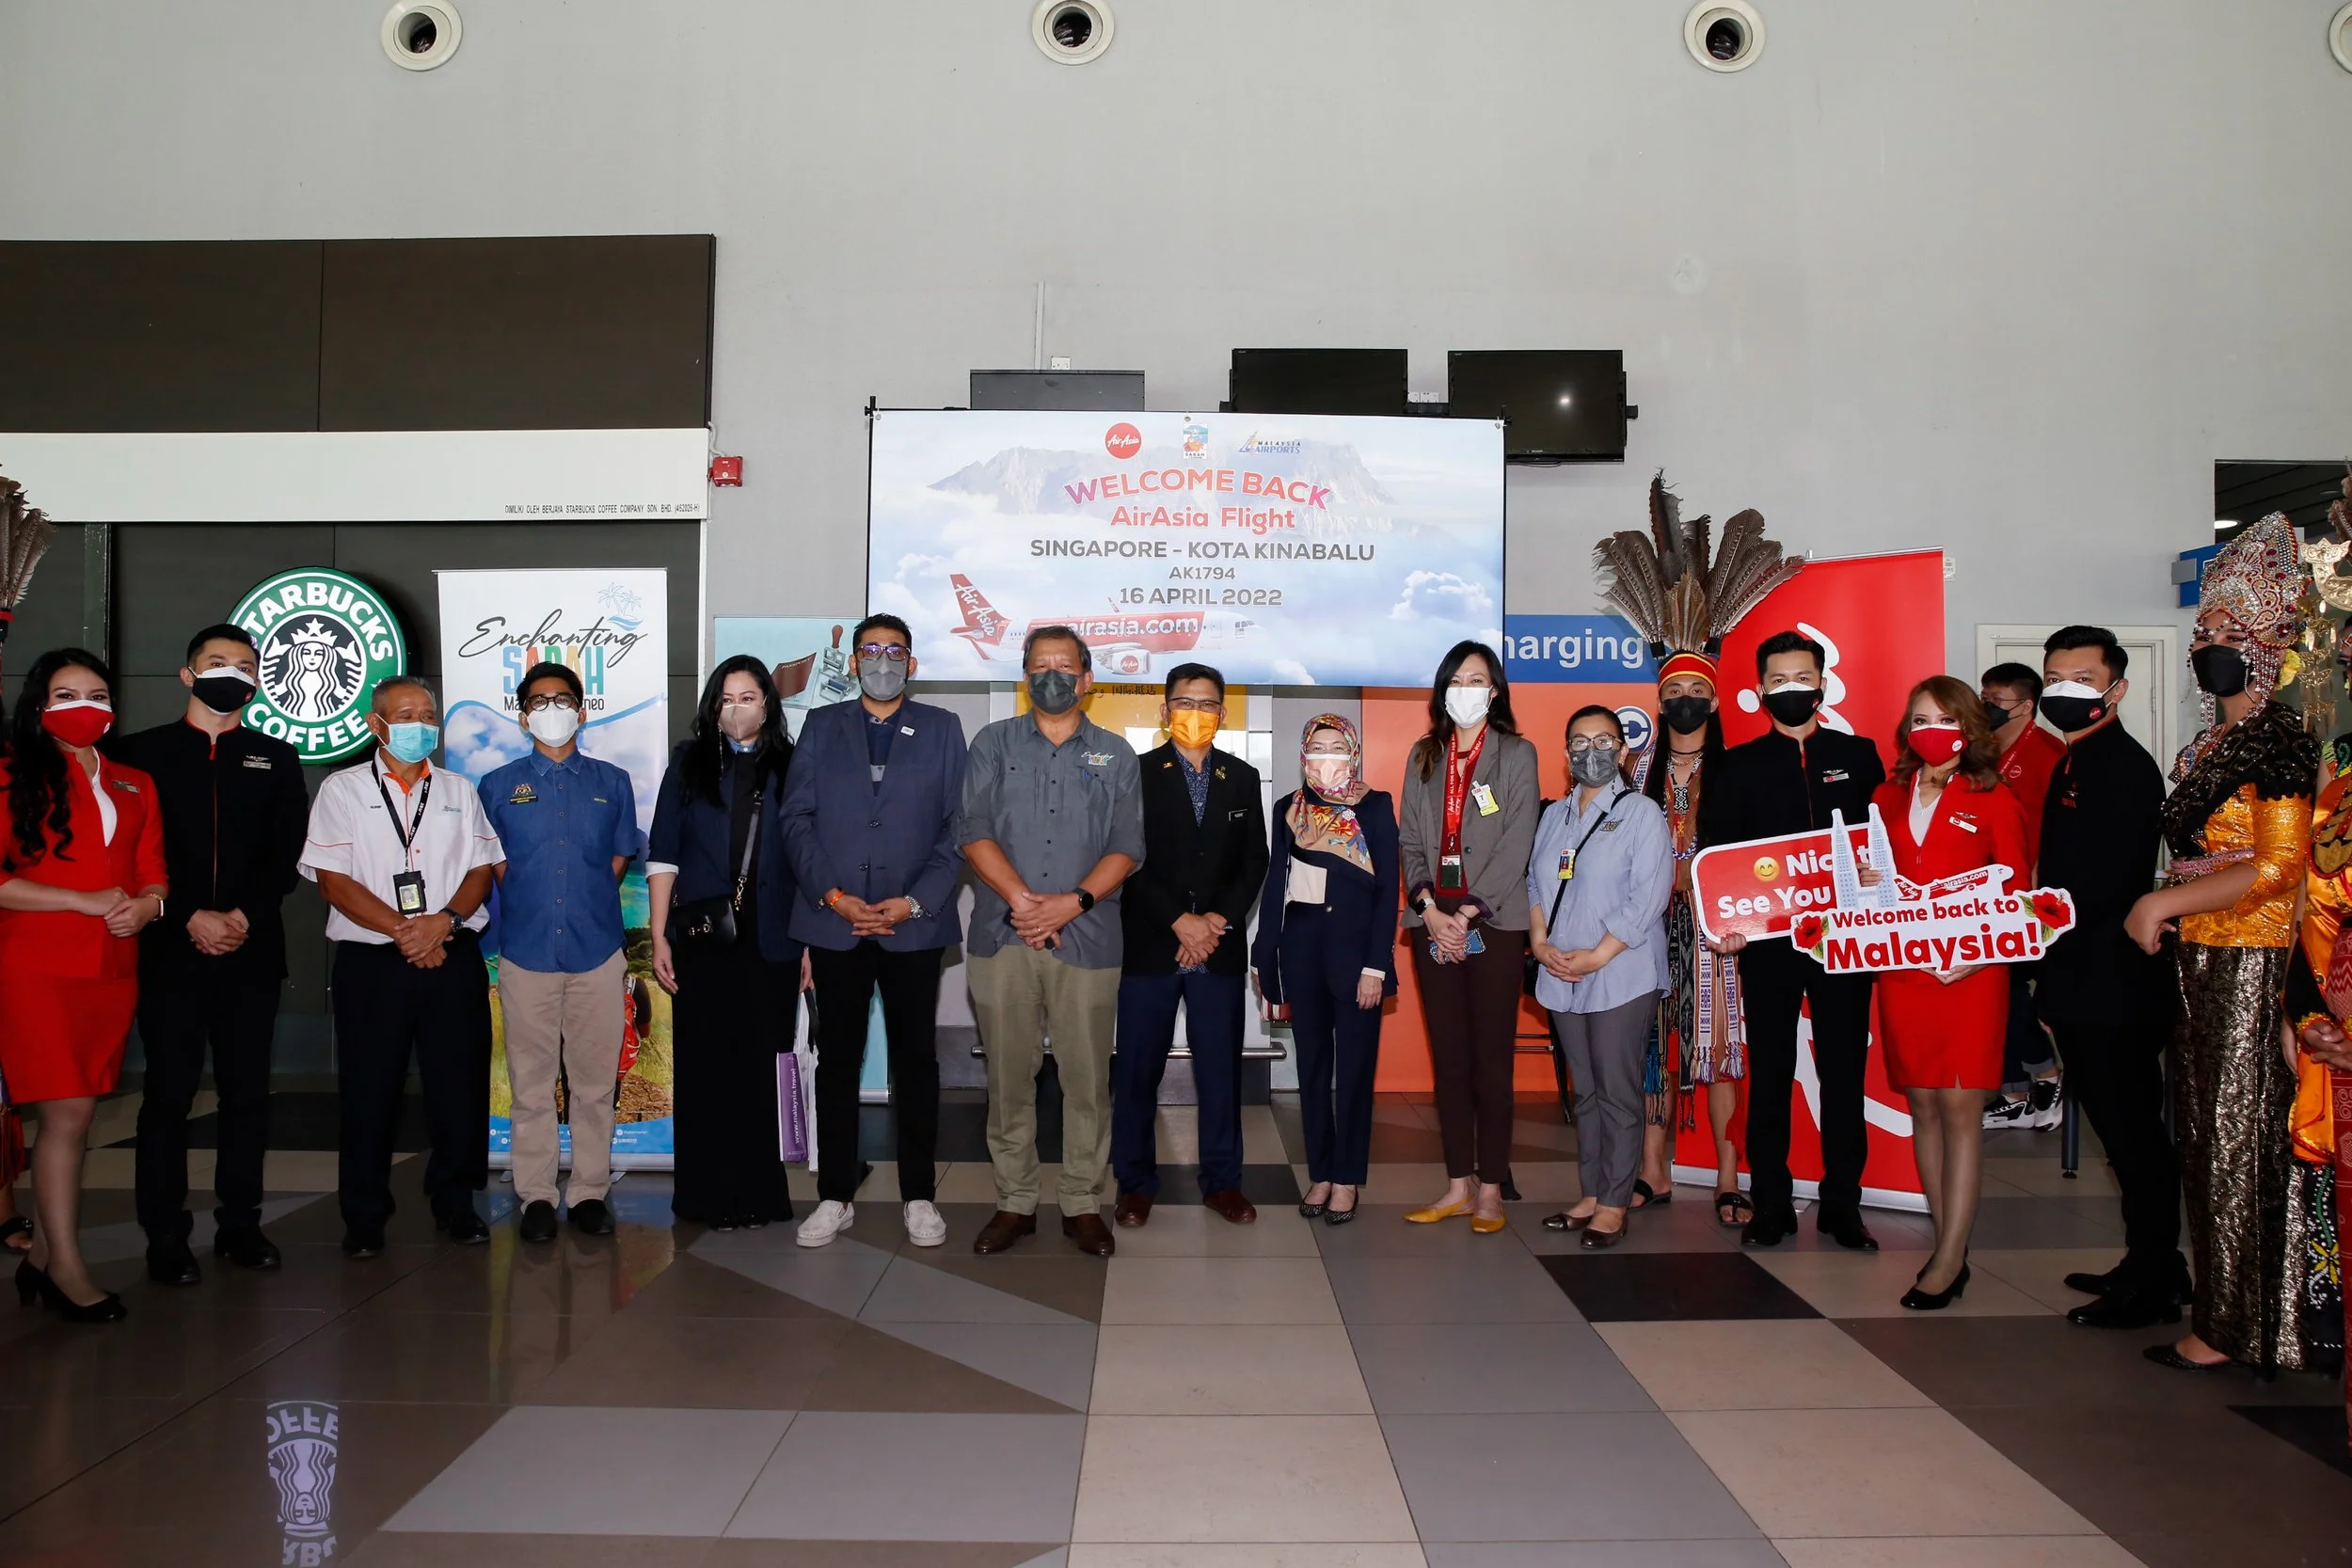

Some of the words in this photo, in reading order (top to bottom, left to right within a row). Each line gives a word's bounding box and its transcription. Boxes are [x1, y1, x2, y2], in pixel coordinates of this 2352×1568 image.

[1255, 446, 1301, 454] AIRPORTS
[1064, 468, 1235, 505] WELCOME
[1242, 471, 1331, 510] BACK
[527, 505, 539, 514] OLEH
[542, 505, 564, 514] BERJAYA
[565, 505, 596, 514] STARBUCKS
[598, 504, 617, 514] COFFEE
[620, 504, 644, 514] COMPANY
[1110, 505, 1209, 527] AirAsia
[1221, 506, 1295, 535] Flight
[1030, 539, 1168, 557] SINGAPORE
[1187, 541, 1250, 559] KOTA
[1254, 543, 1375, 562] KINABALU
[1168, 566, 1236, 580] AK1794
[1120, 587, 1145, 605] 16
[1149, 588, 1218, 606] APRIL
[1221, 589, 1283, 607] 2022
[242, 581, 394, 662] TARBUCKS
[458, 609, 648, 669] Enchanting
[1505, 628, 1644, 669] arging
[246, 703, 369, 752] COFFEE
[1785, 848, 1834, 878] Nic
[1943, 870, 1988, 889] airasia.com
[1717, 895, 1771, 919] See
[1773, 885, 1831, 910] You
[1832, 907, 1928, 928] Welcome
[1932, 898, 1989, 920] back
[1994, 896, 2019, 914] to
[1827, 922, 2041, 972] Malaysia!
[790, 1068, 799, 1144] www.malaysia.travel
